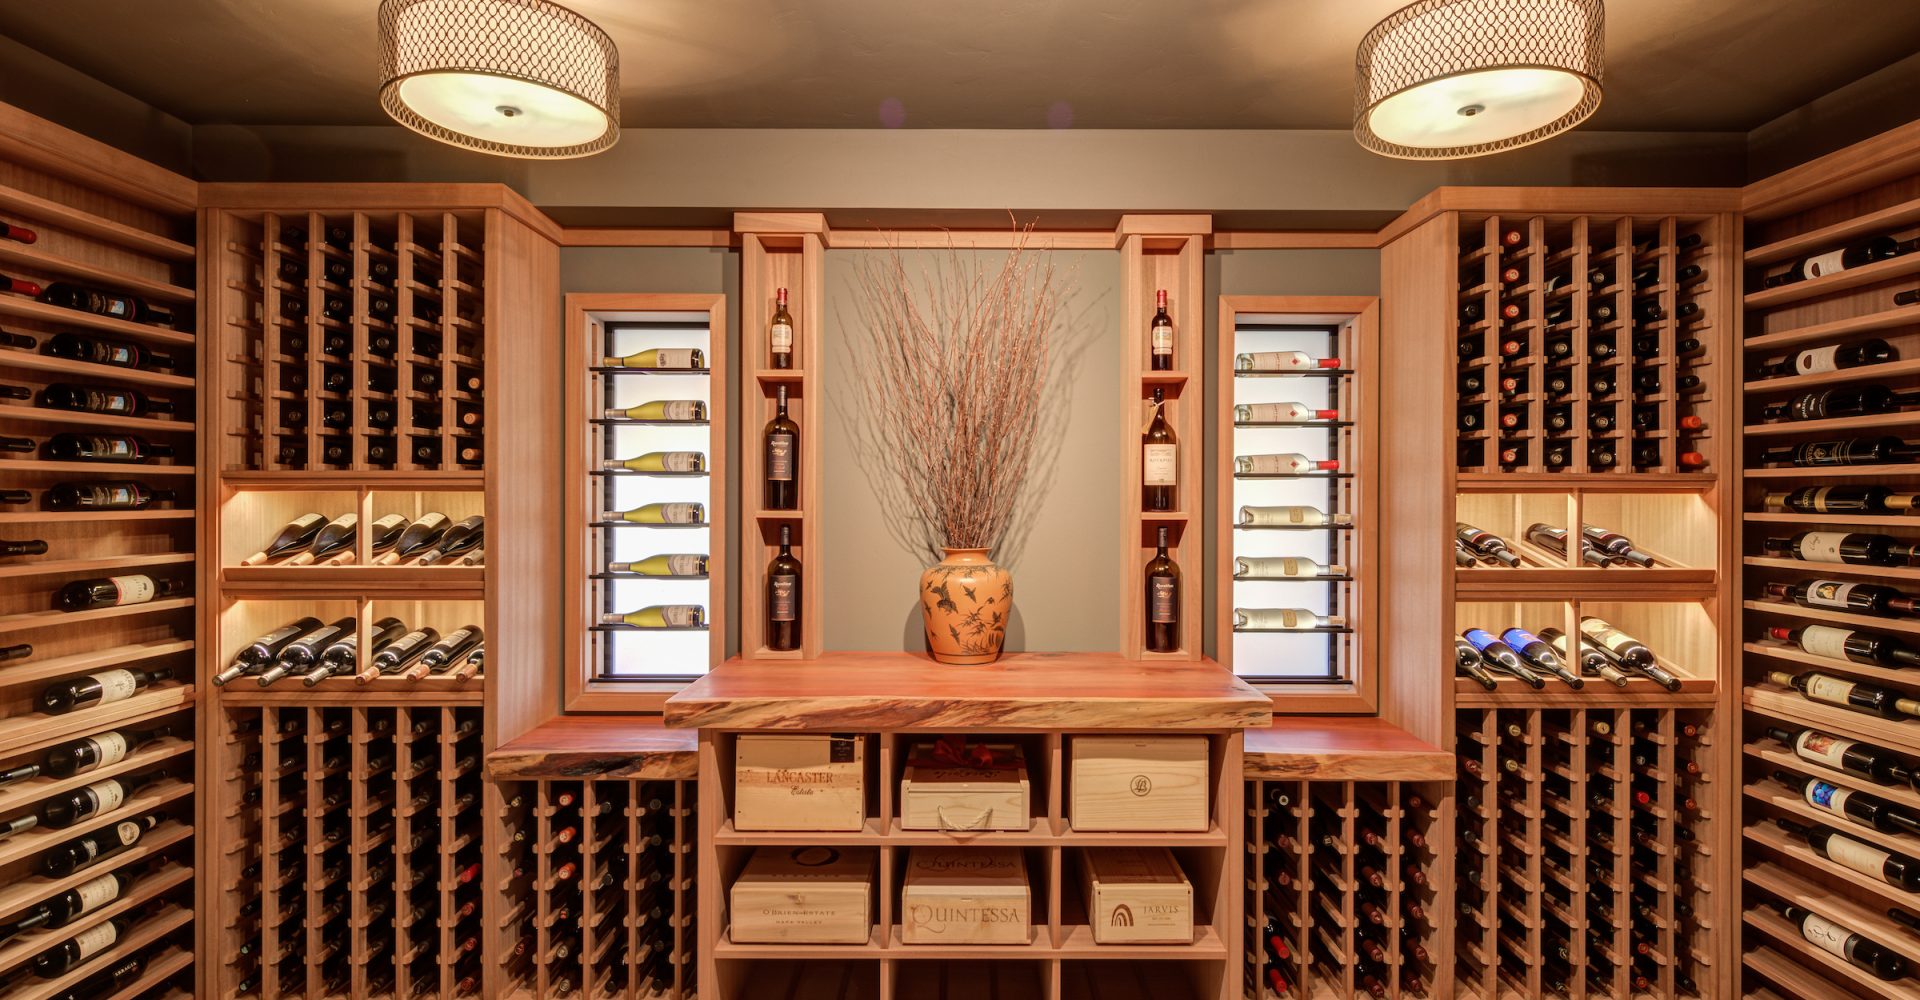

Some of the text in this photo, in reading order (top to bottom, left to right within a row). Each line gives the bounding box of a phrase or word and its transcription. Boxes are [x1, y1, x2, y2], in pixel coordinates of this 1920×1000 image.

[766, 771, 834, 784] LANCASTER
[790, 785, 814, 796] Estate
[1143, 905, 1180, 914] JARVIS
[910, 904, 1020, 934] QUINTESSA
